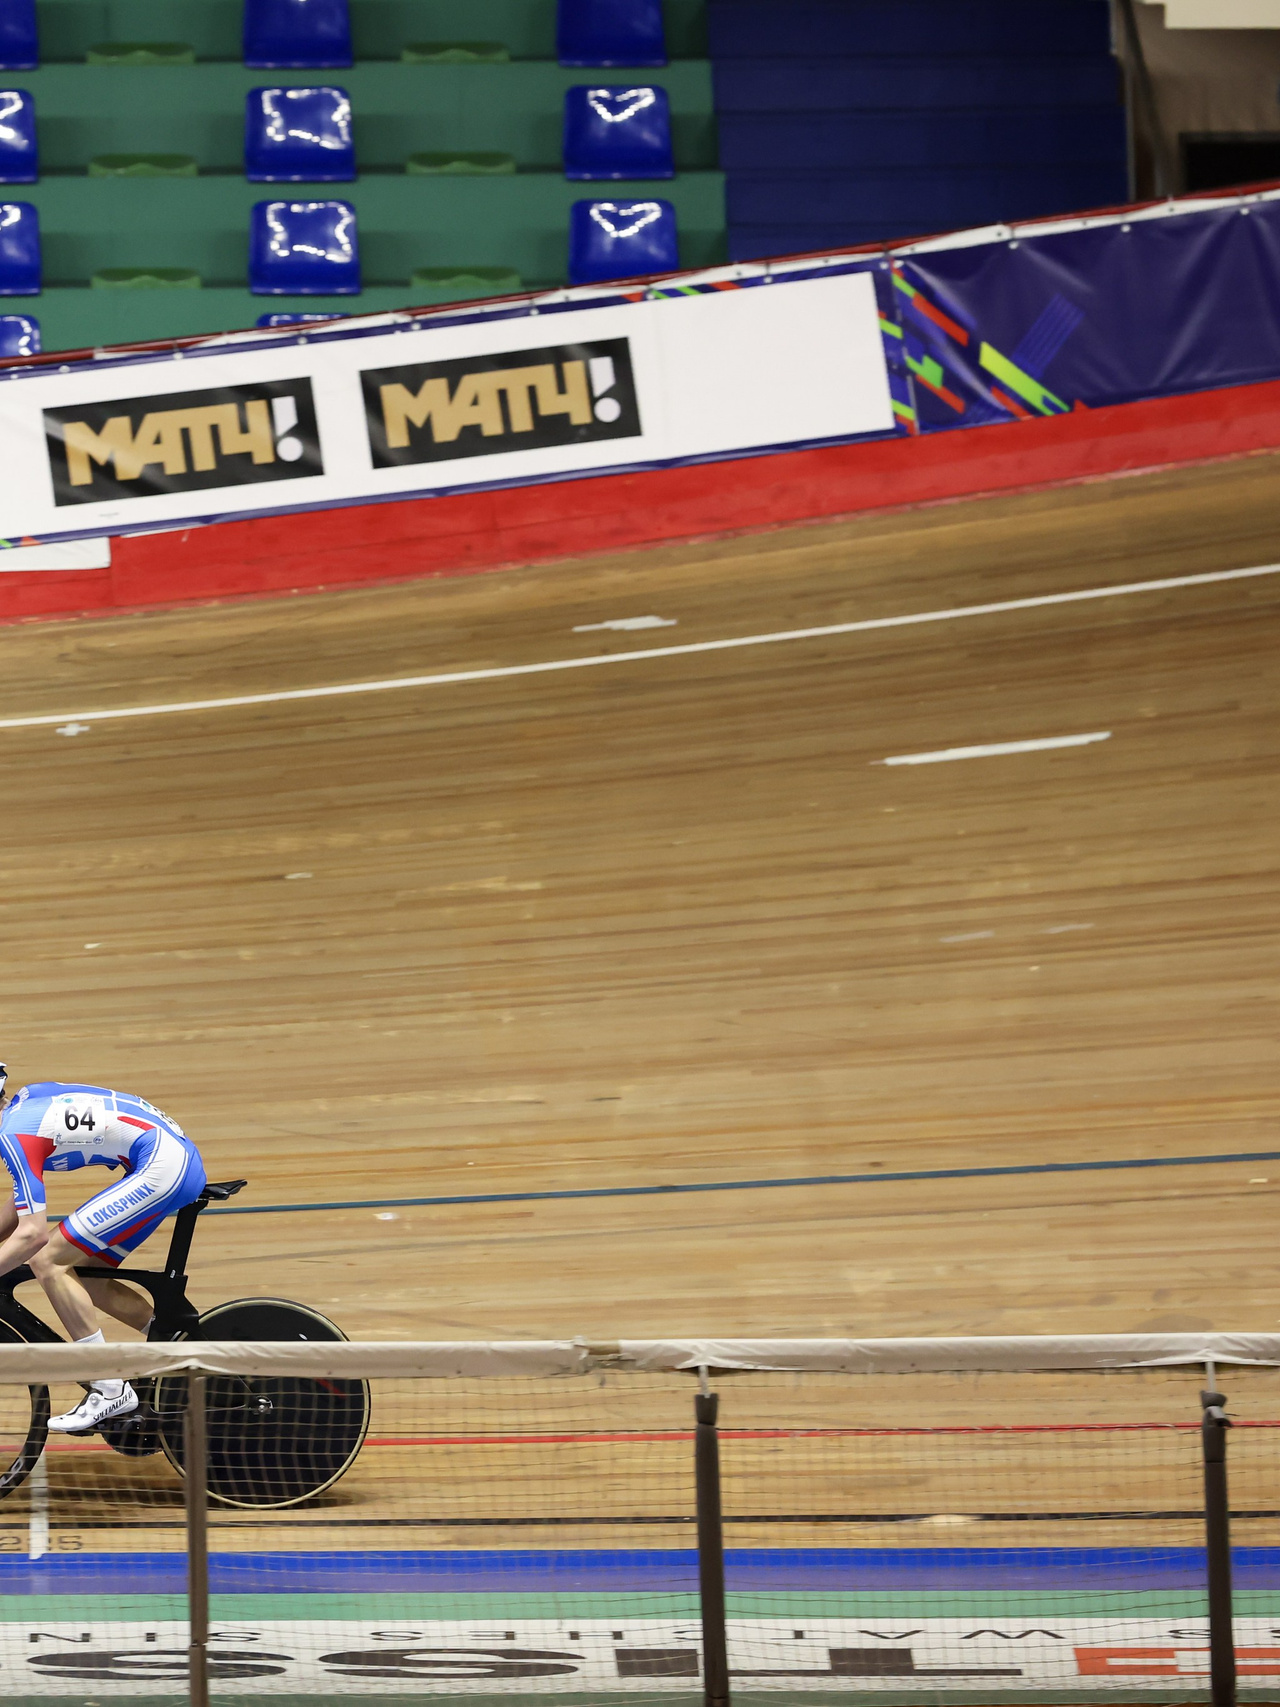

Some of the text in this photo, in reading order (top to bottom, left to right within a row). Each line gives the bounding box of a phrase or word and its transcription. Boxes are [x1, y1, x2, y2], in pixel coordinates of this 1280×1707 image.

[380, 356, 621, 448] МАТЧ!
[63, 395, 304, 486] МАТЧ!
[64, 1105, 96, 1132] 64
[86, 1182, 156, 1228] LOKOSPHINX
